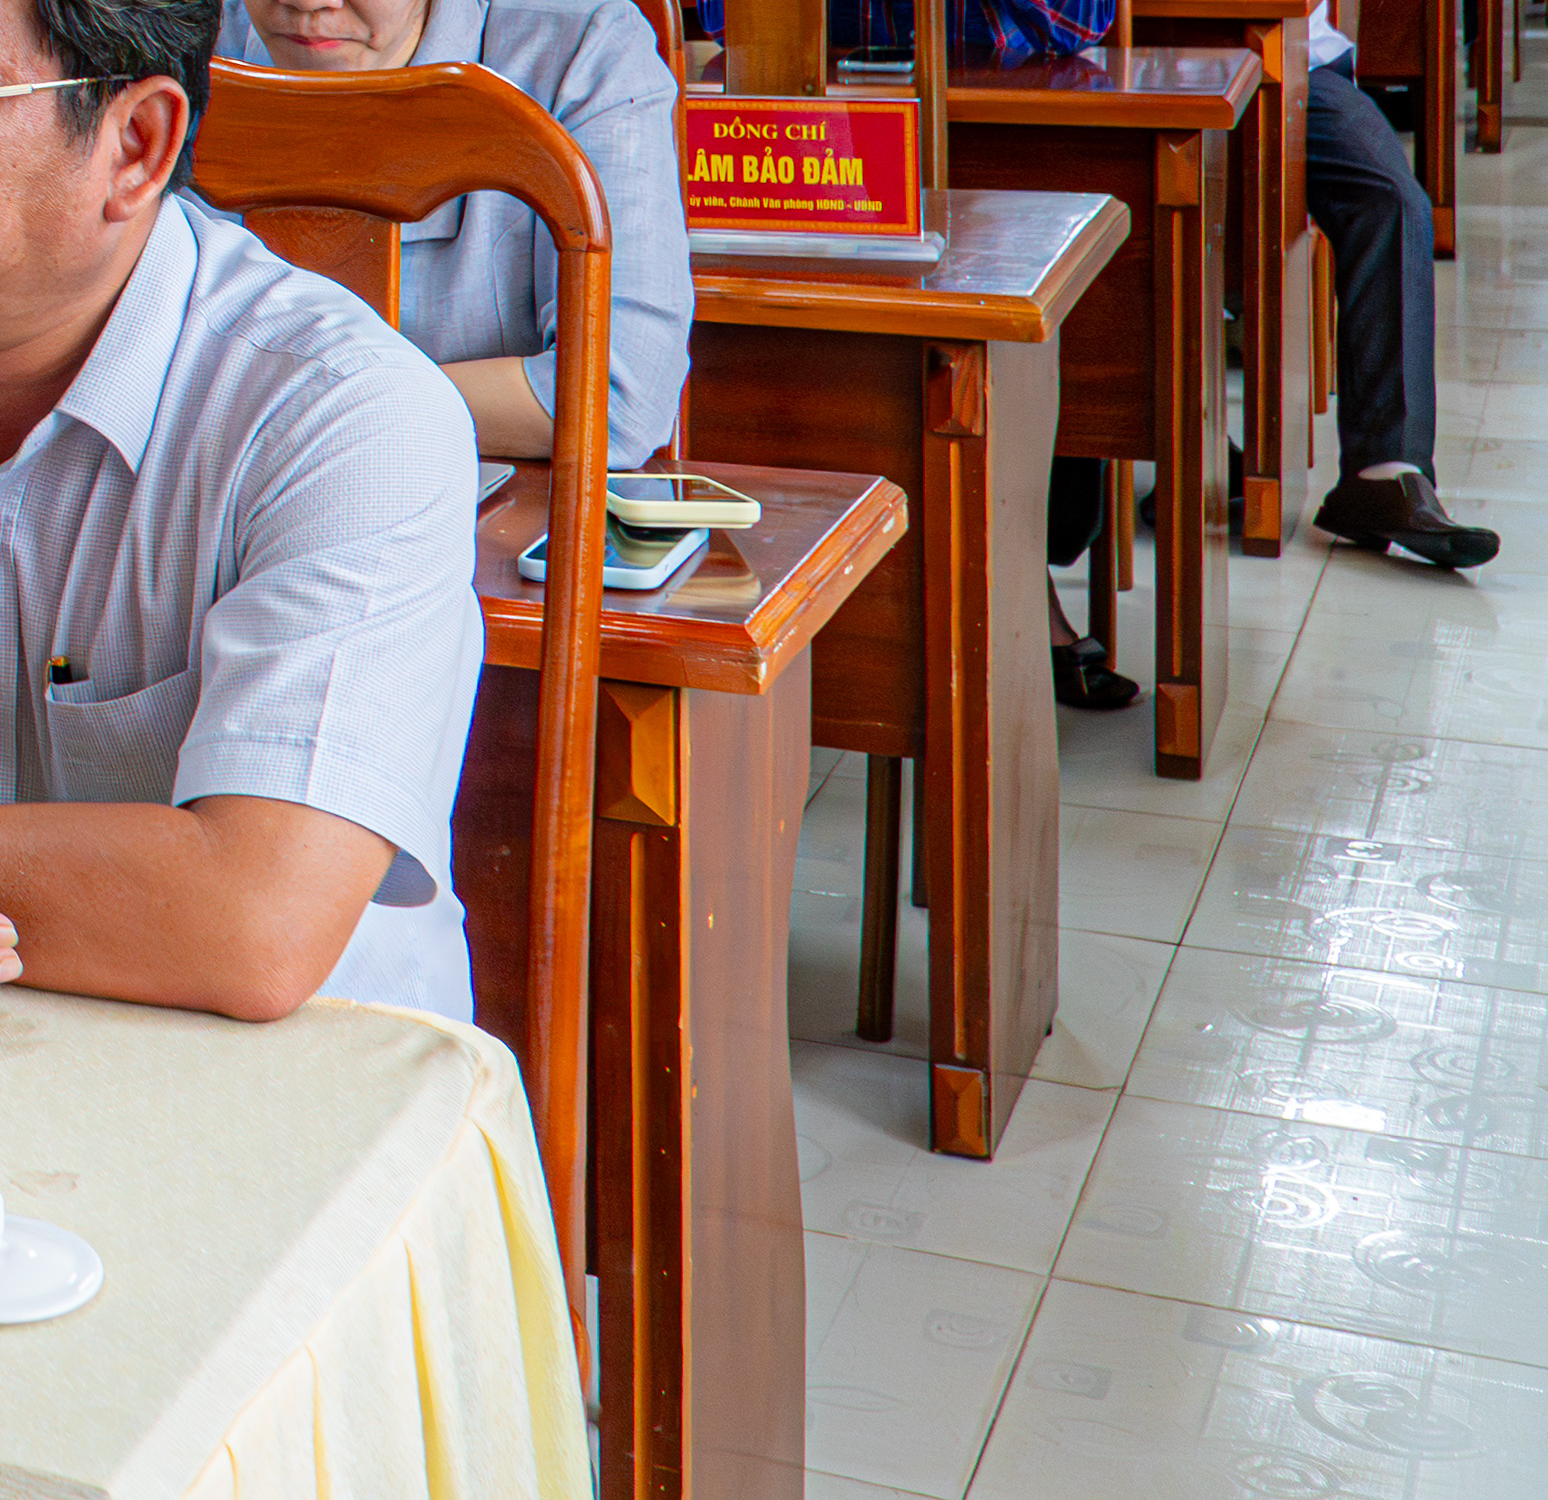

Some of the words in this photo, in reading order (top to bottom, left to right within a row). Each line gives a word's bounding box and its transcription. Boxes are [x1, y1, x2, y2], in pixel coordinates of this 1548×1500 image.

[713, 115, 778, 140] ĐỒNG
[785, 121, 826, 141] CHÍ
[742, 146, 795, 185] BẢO
[802, 148, 864, 186] ĐẢM
